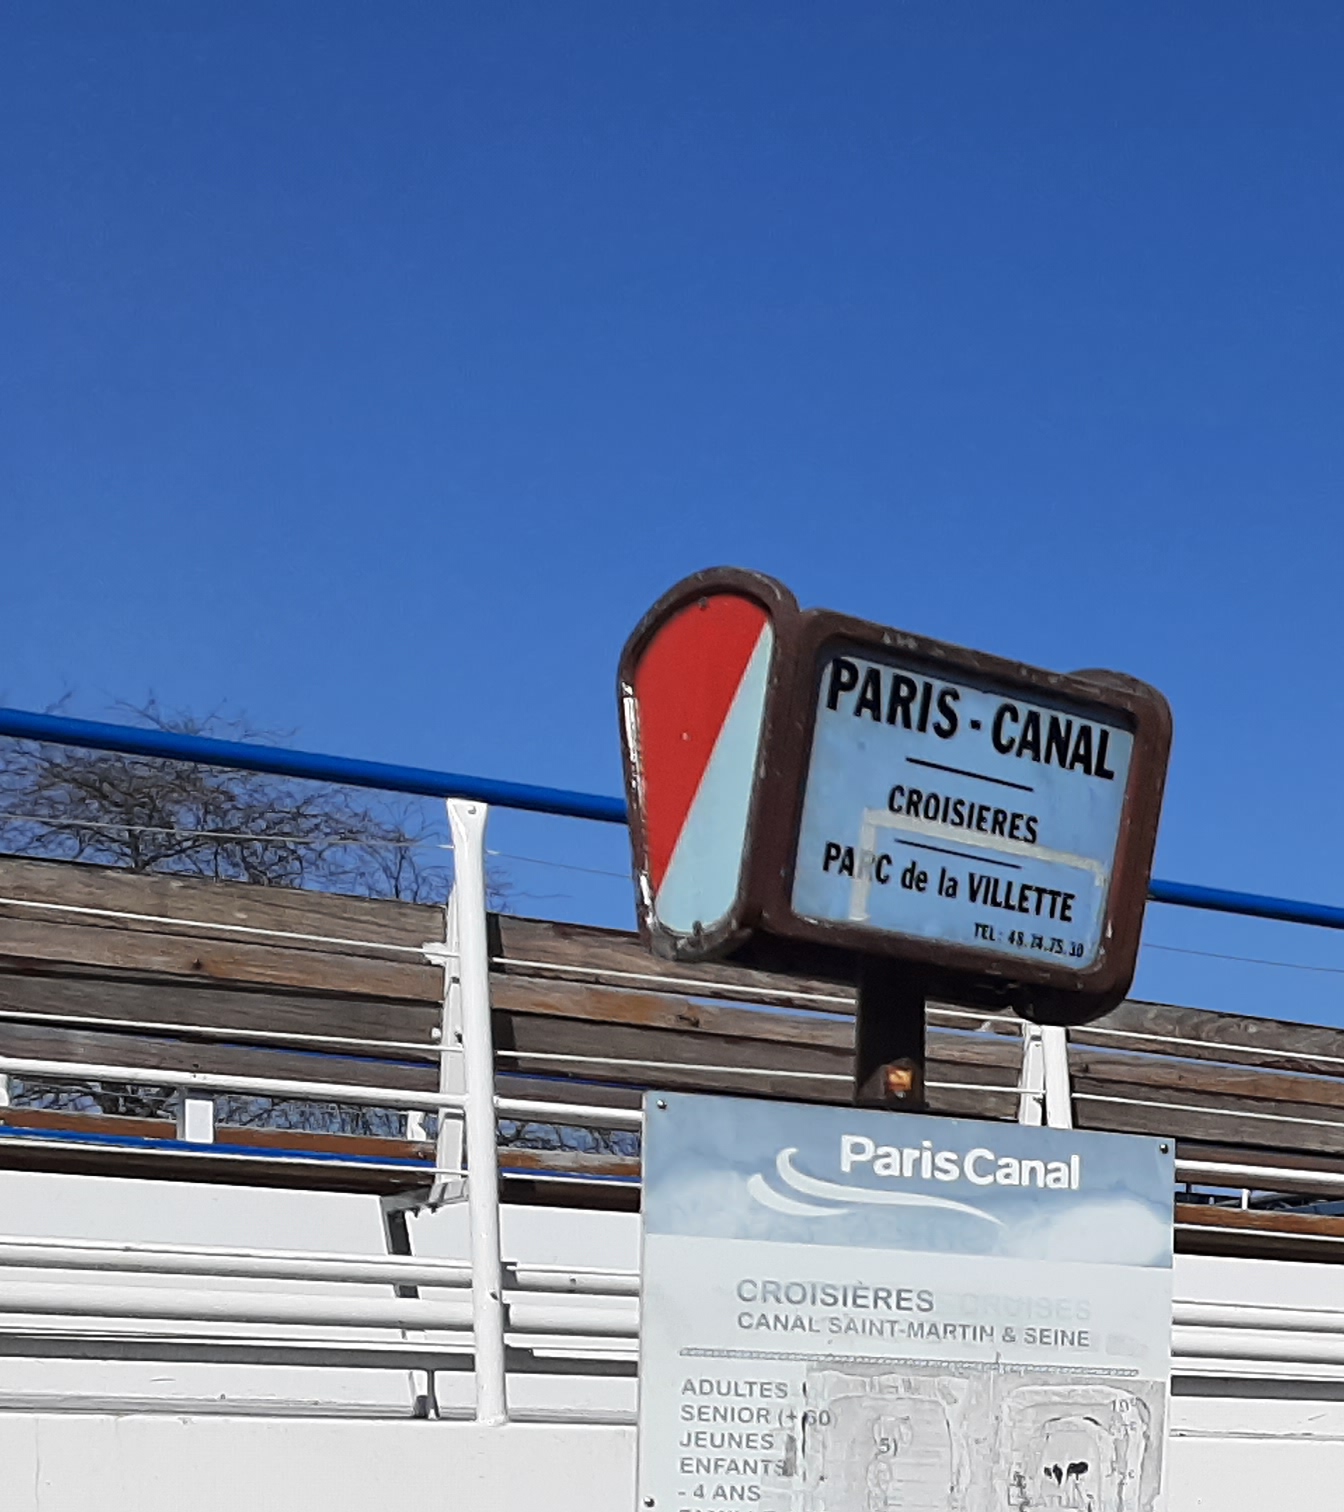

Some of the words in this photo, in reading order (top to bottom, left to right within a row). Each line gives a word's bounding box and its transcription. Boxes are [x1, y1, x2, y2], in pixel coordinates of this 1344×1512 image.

[826, 657, 959, 739] PARIS
[991, 702, 1115, 781] CANAL
[888, 784, 1039, 845] CROISIERES
[901, 859, 928, 893] de
[938, 866, 959, 899] la
[969, 871, 1076, 923] VILLETTE
[736, 1278, 935, 1313] CROISIÈRES
[737, 1311, 821, 1334] CANAL
[828, 1316, 995, 1343] SAINT-MARTIN
[1001, 1326, 1017, 1343] &
[1023, 1327, 1090, 1347] SEINE
[681, 1378, 789, 1399] ADULTES
[680, 1404, 771, 1425] SENIOR
[679, 1431, 775, 1451] JEUNES
[679, 1456, 787, 1475] ENFANTS
[692, 1484, 706, 1500] 4
[711, 1484, 762, 1501] ANS
